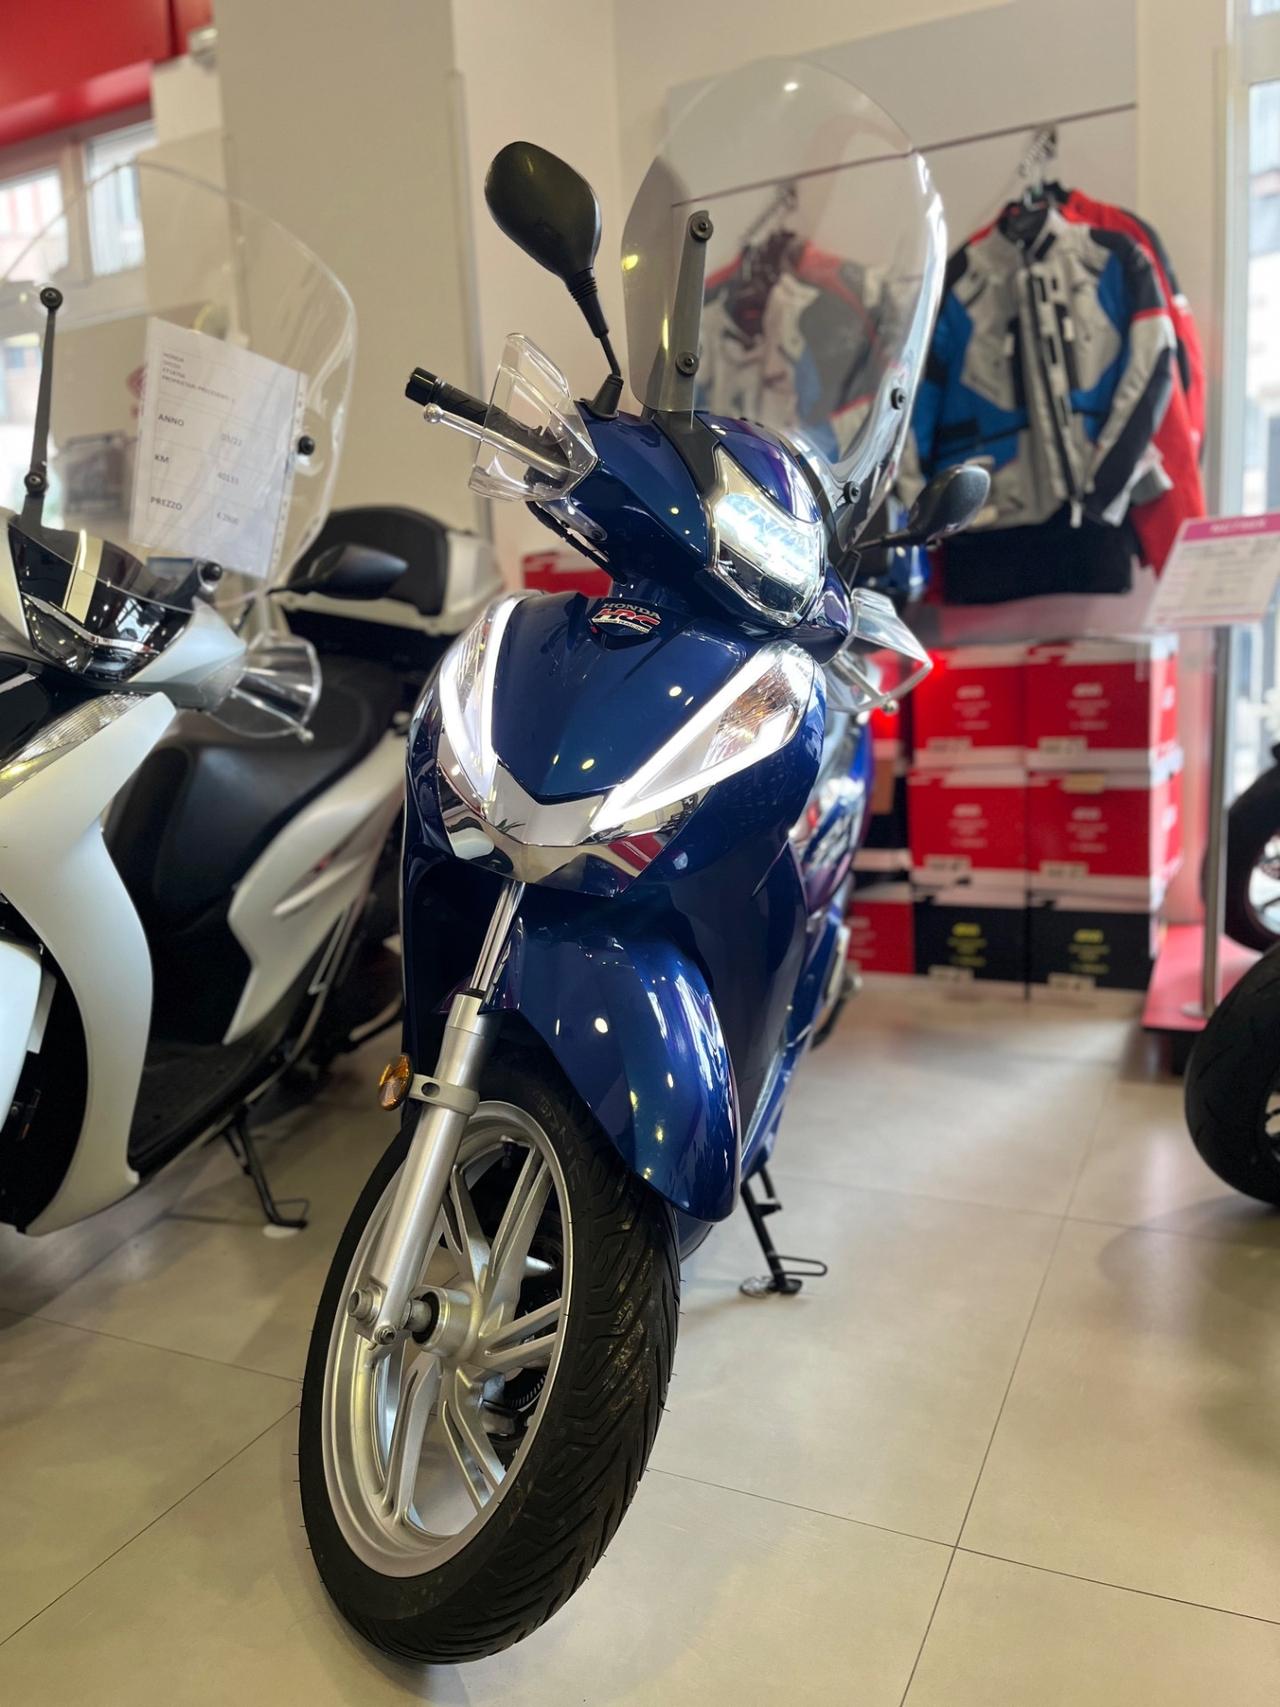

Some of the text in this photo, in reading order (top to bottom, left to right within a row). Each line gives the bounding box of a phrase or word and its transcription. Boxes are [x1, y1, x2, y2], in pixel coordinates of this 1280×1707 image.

[158, 413, 185, 428] ANNO
[154, 453, 170, 465] KM
[150, 496, 183, 512] PREZZO
[592, 608, 661, 629] HRC
[601, 603, 662, 620] HONDA
